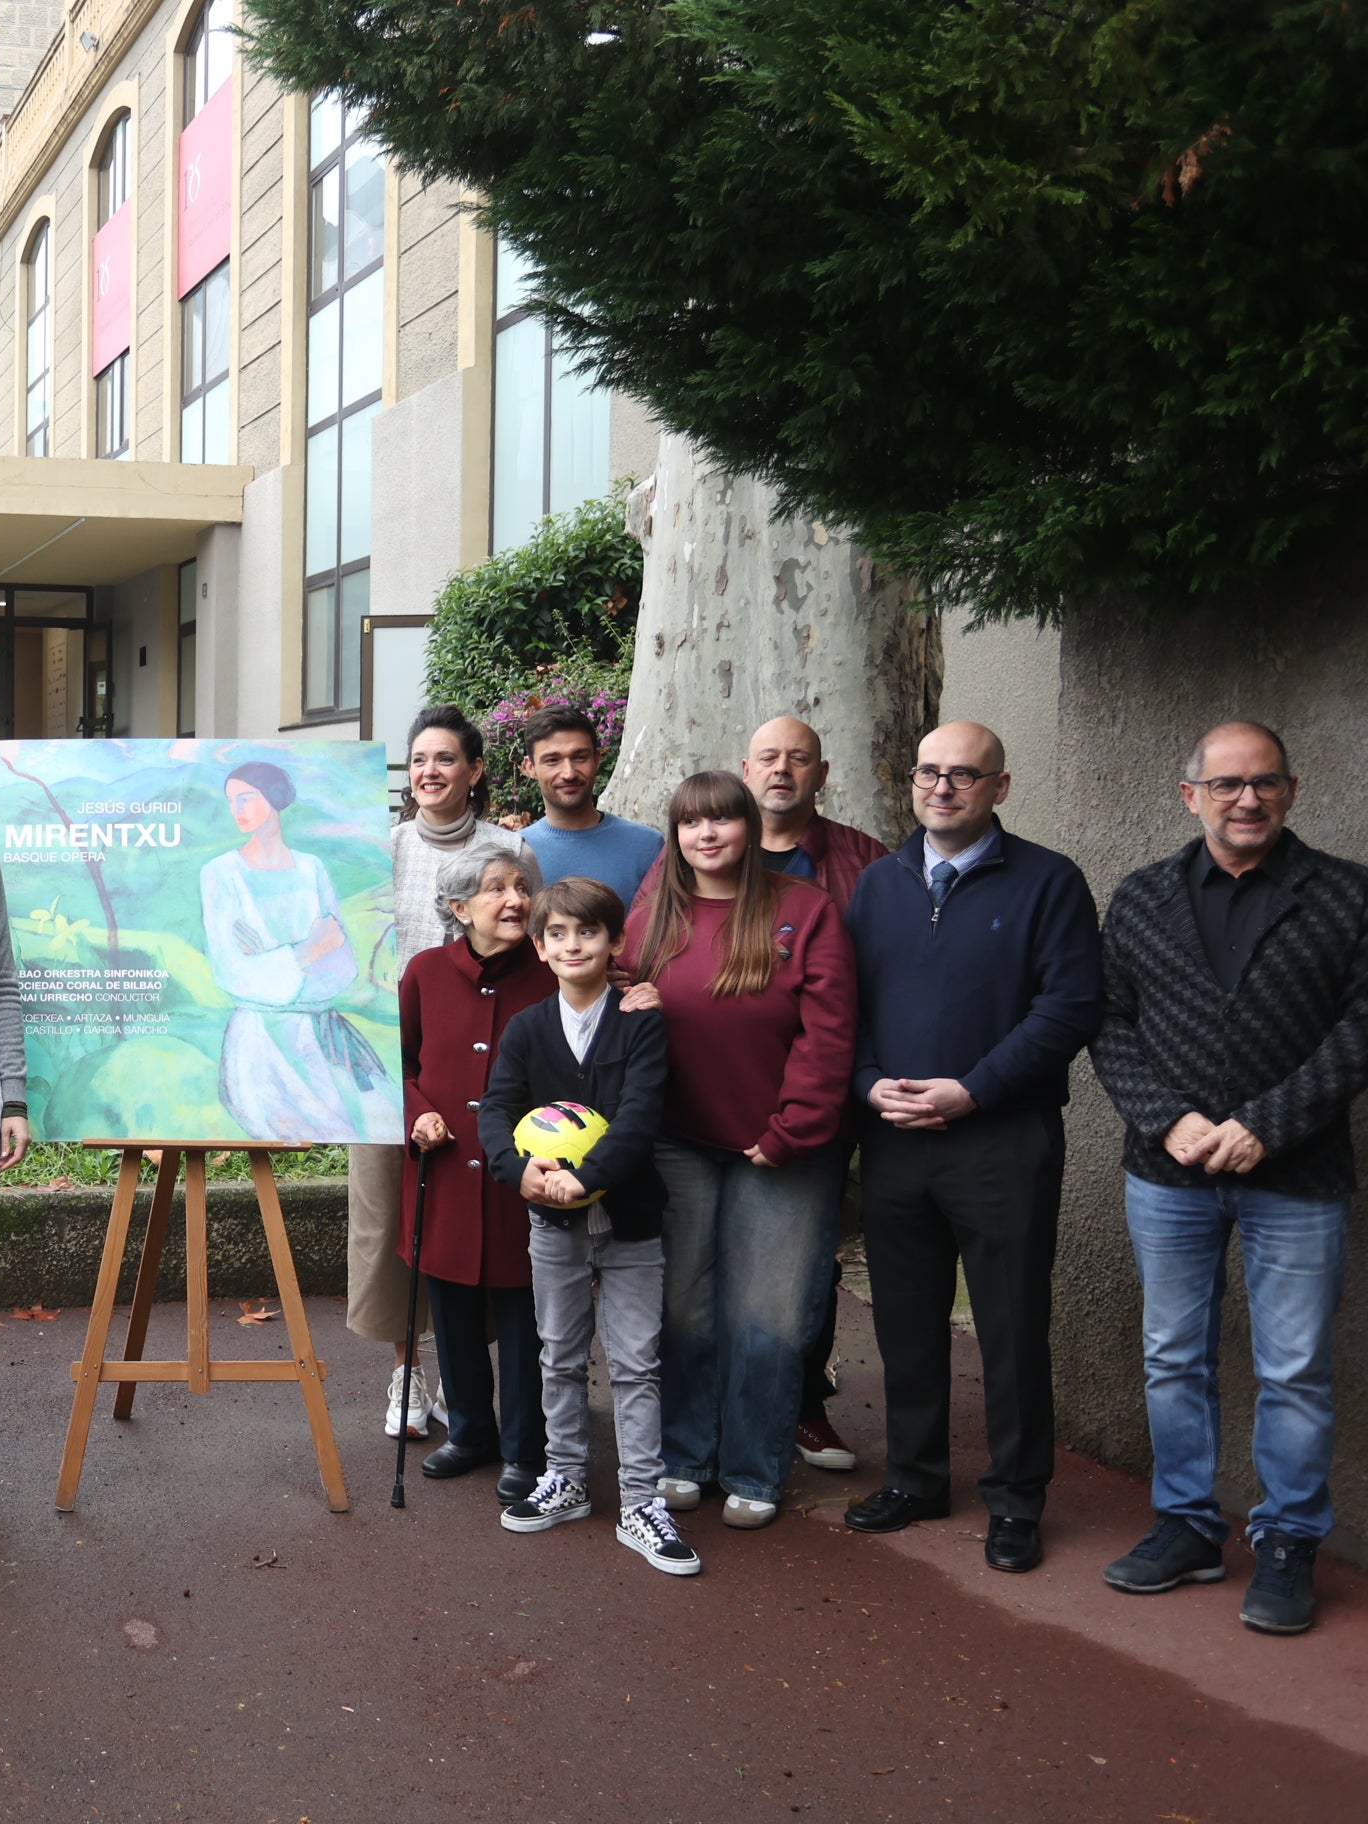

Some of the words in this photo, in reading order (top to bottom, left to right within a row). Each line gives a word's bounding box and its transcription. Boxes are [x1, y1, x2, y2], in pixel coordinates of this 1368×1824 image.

[76, 800, 126, 815] JESÚS
[129, 801, 182, 815] GURIDI
[5, 823, 181, 848] MIRENTXU
[3, 851, 58, 863] BASQUE
[60, 851, 106, 862] OPERA
[17, 969, 42, 979] BAO
[43, 969, 102, 979] ORKESTRA
[103, 968, 170, 979] SINFONIKOA
[18, 981, 64, 990] OCIEDAD
[66, 981, 104, 990] CORAL
[105, 981, 122, 990] DE
[122, 980, 163, 990] BILBAO
[20, 993, 37, 1002] NAI
[39, 993, 93, 1002] URRECHO
[94, 992, 160, 1002] CONDUCTOR
[73, 1013, 113, 1023] ARTAZA
[122, 1013, 171, 1023] MUNGUIA
[25, 1026, 73, 1035] CASTILLO
[83, 1026, 122, 1035] GARCIA
[123, 1026, 168, 1035] SANCHO
